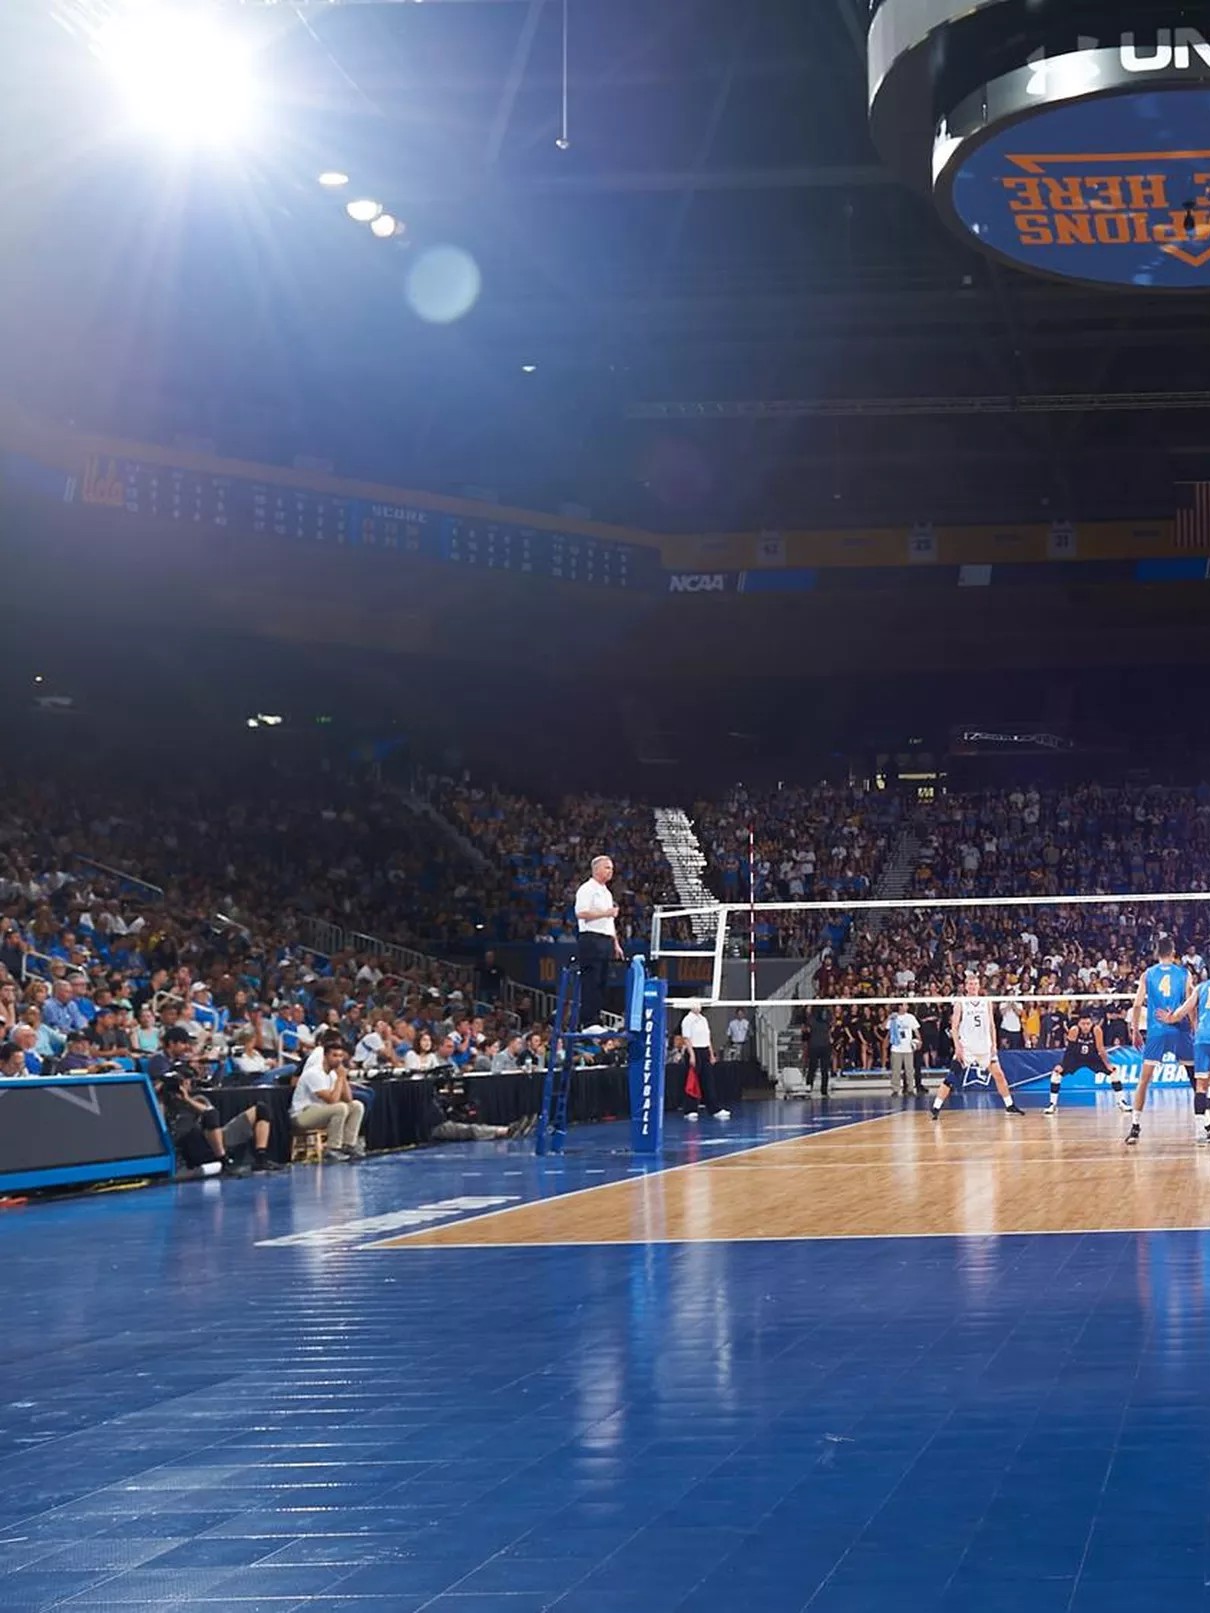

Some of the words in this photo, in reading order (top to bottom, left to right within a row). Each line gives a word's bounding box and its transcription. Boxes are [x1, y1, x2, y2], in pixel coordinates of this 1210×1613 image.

[1002, 174, 1169, 212] HERE
[668, 575, 725, 593] NCAA
[1157, 974, 1172, 998] 4
[974, 1015, 981, 1027] 5
[642, 1008, 654, 1135] VOLLEYBALL
